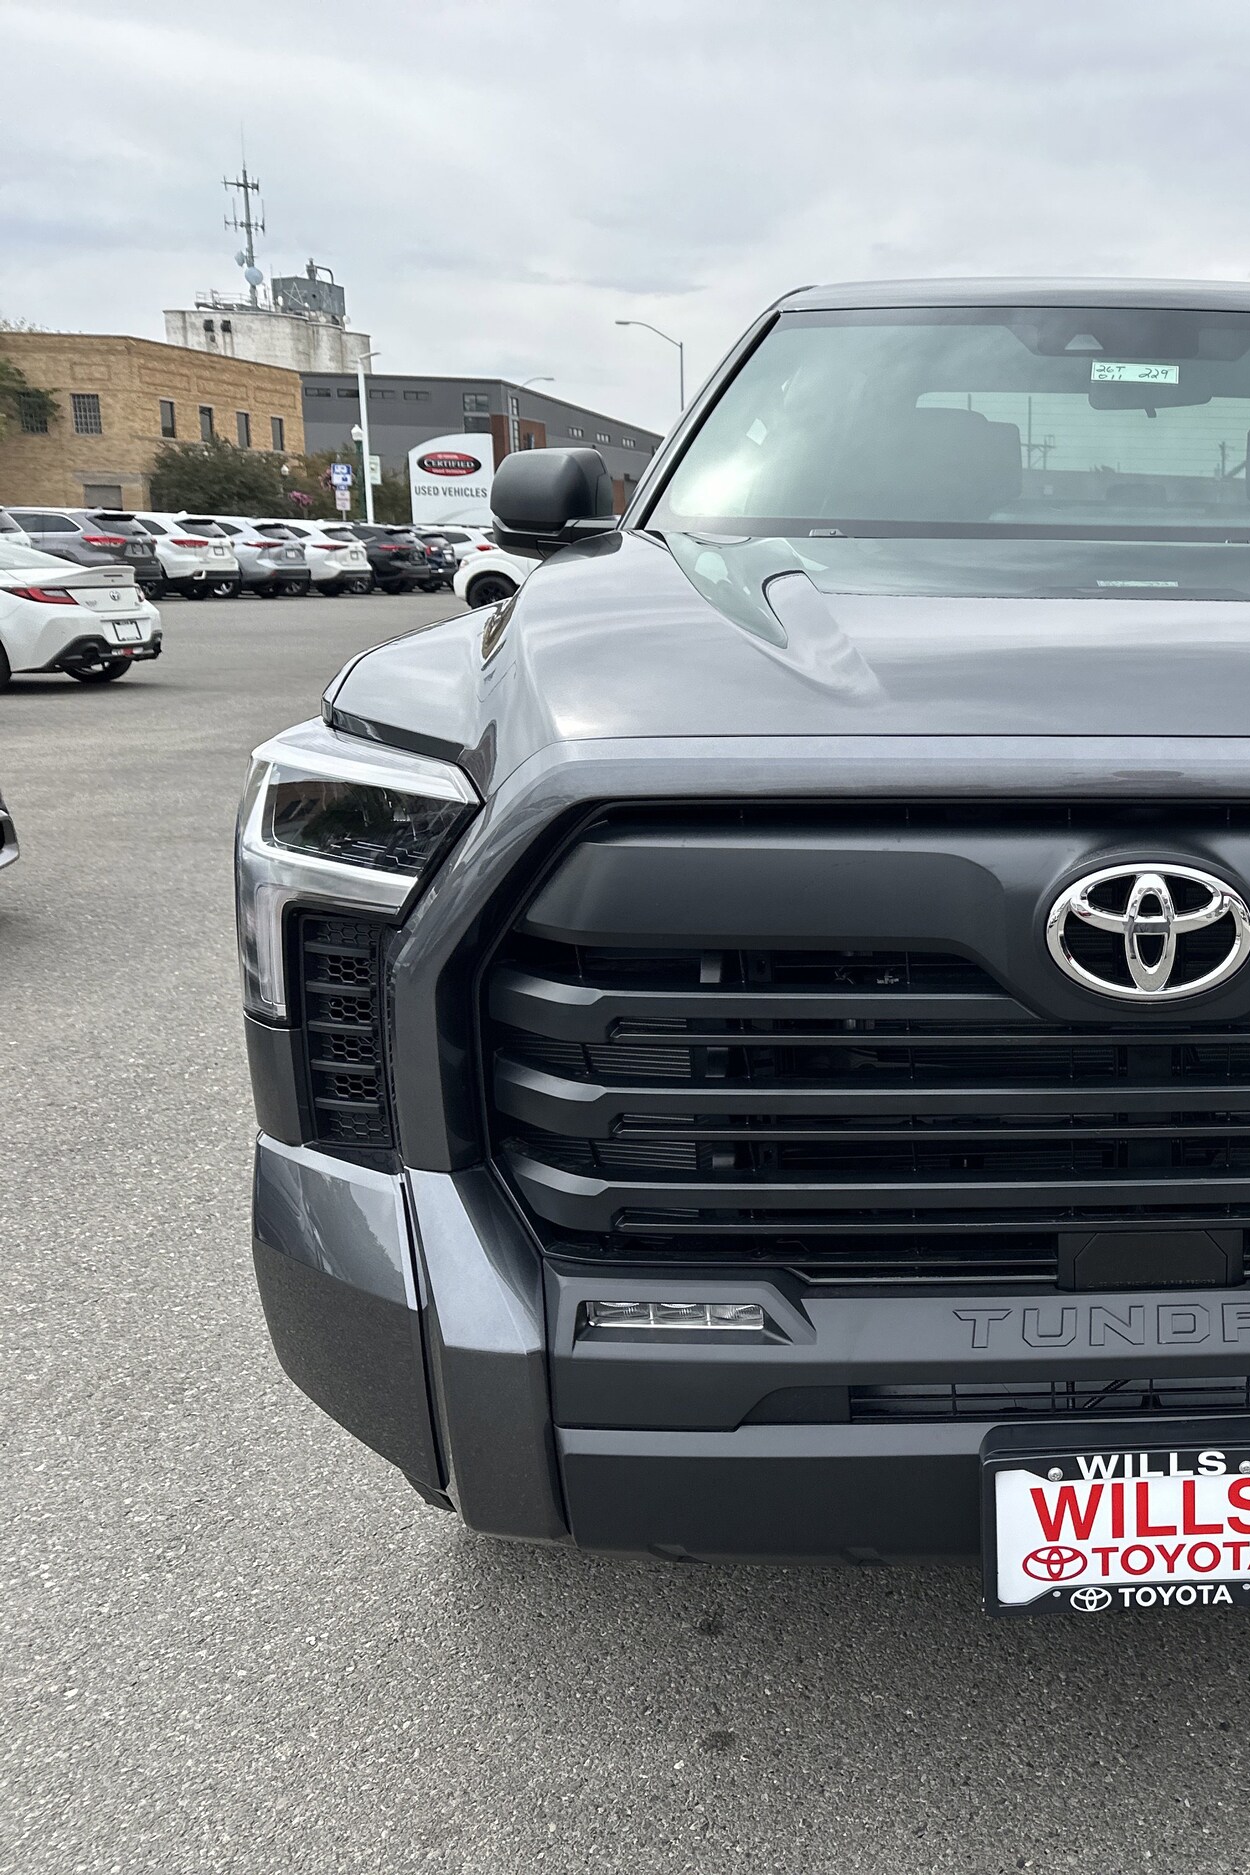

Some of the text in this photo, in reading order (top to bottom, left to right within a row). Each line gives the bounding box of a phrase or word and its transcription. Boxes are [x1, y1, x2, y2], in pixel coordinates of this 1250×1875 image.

[414, 485, 488, 498] USED VEHICLES
[1076, 1451, 1227, 1480] WILLS
[1118, 1584, 1233, 1608] TOYOTA
